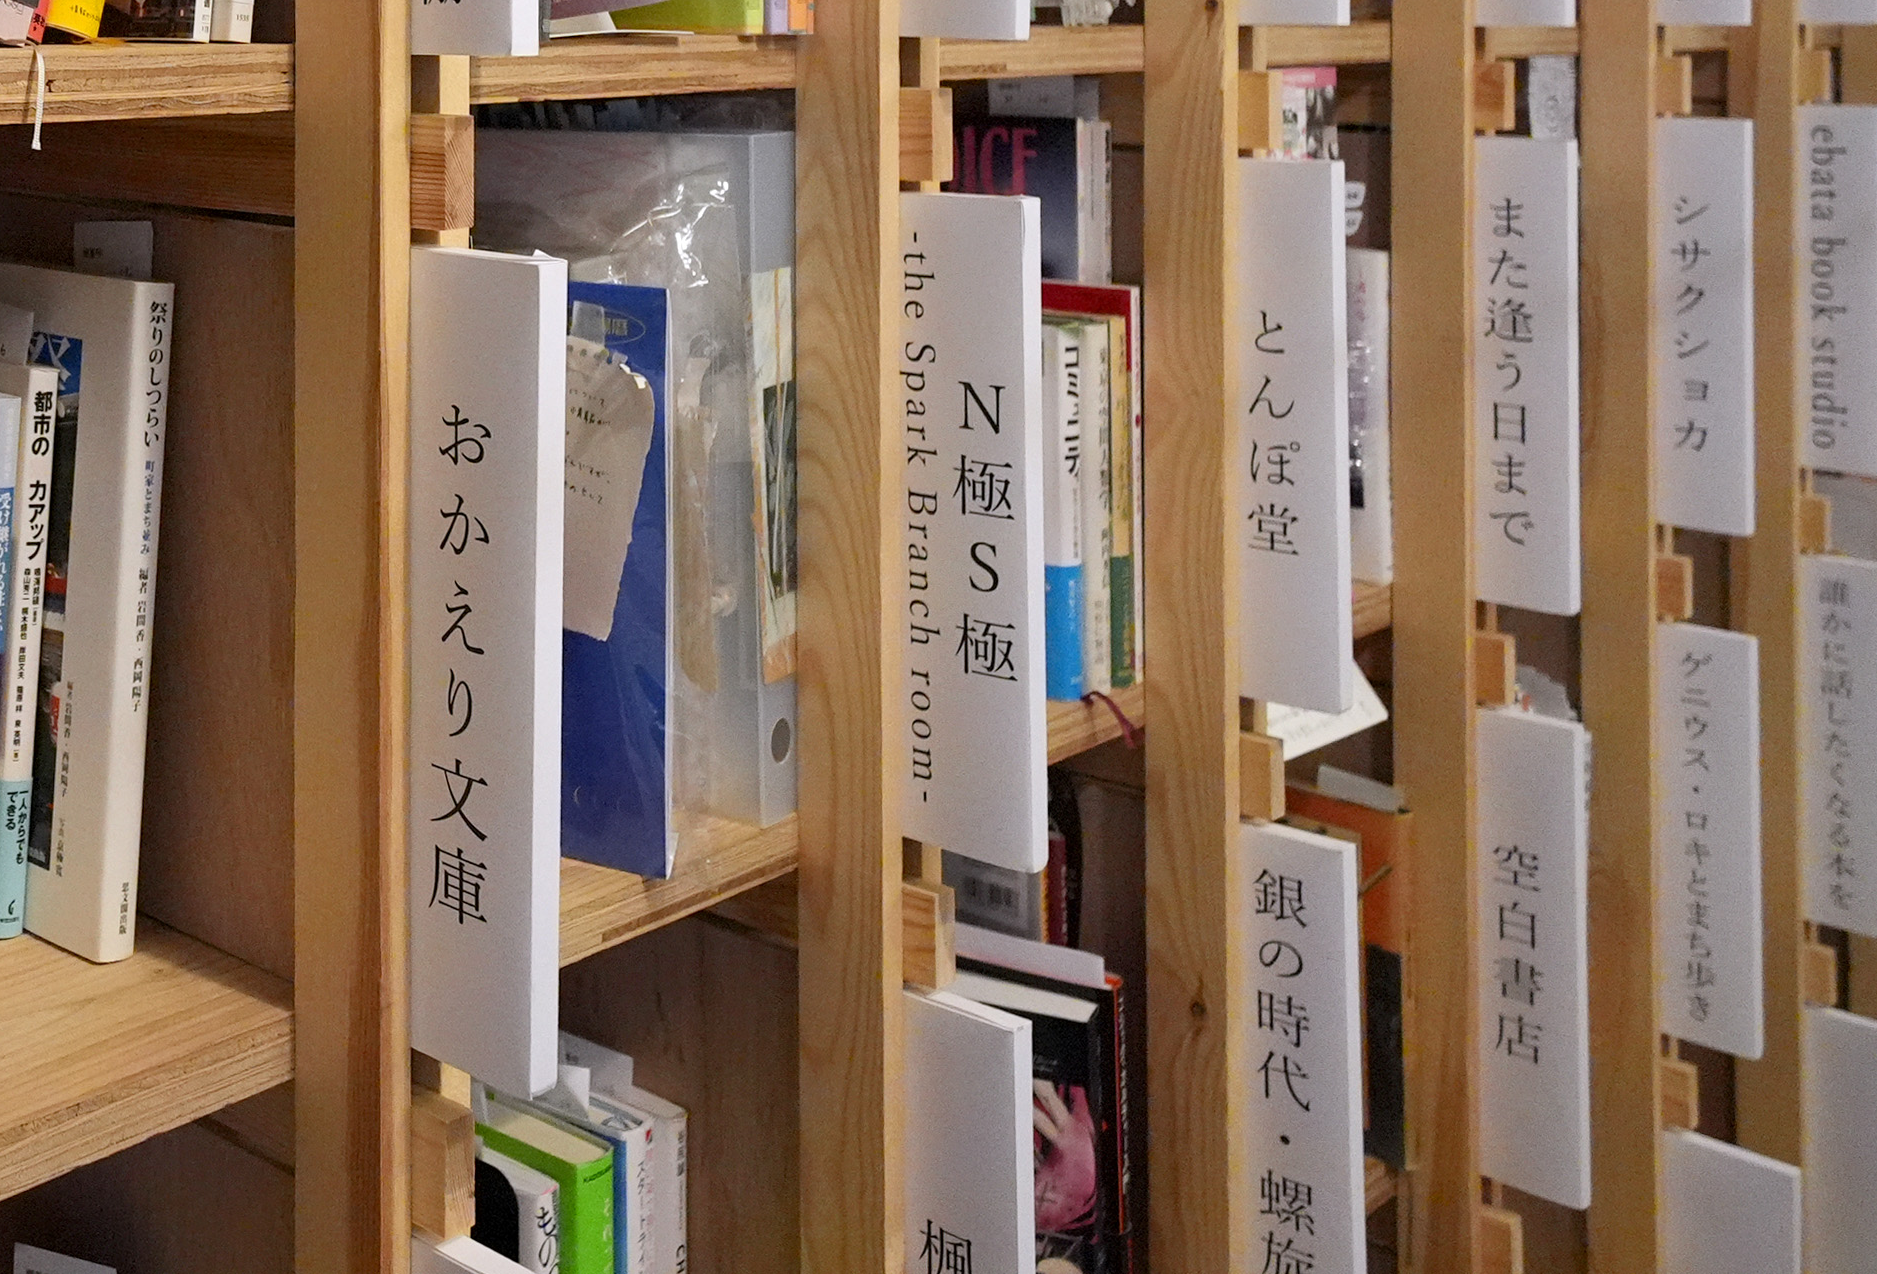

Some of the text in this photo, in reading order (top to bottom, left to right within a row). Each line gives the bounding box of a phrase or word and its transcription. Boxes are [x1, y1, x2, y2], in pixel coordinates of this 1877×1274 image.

[145, 299, 169, 449] 祭りのしつらい
[1485, 198, 1534, 546] また逢う日まで
[1672, 195, 1710, 452] シサクショカ
[1810, 124, 1847, 450] ebata book studio
[31, 390, 53, 457] 都市の
[899, 340, 938, 465] Spark
[139, 459, 156, 556] 町家とまち並み
[906, 490, 939, 647] Branch
[952, 380, 1019, 682] N極S極
[429, 404, 493, 926] おかえり文庫
[5, 791, 18, 831] できる
[15, 789, 29, 865] 一人からでも
[1494, 844, 1543, 1064] 空白書店
[1253, 869, 1315, 1274] 銀の時代・螺旋
